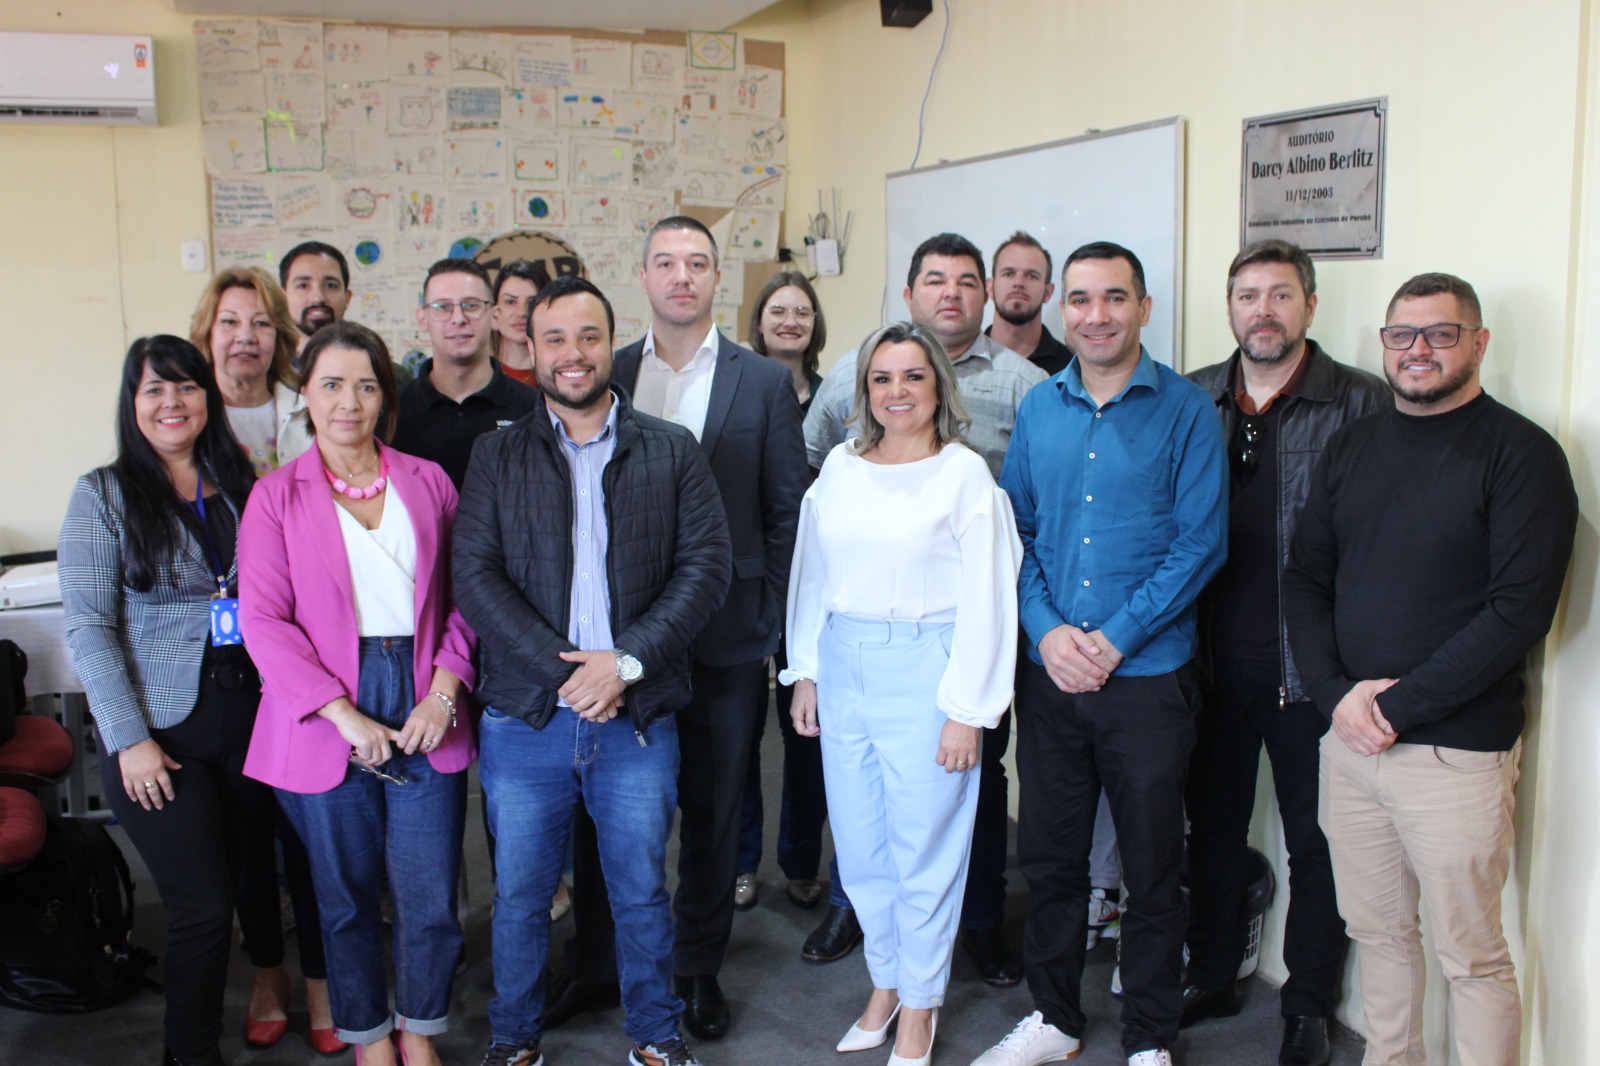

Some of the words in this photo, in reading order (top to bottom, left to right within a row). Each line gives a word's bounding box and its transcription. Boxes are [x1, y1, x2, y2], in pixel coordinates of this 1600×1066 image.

[1287, 129, 1335, 148] AUDITÓRIO
[1251, 161, 1284, 180] Darcy
[1286, 154, 1326, 175] Albino
[1329, 148, 1373, 171] Berlitz
[1285, 186, 1334, 203] 11/12/2003
